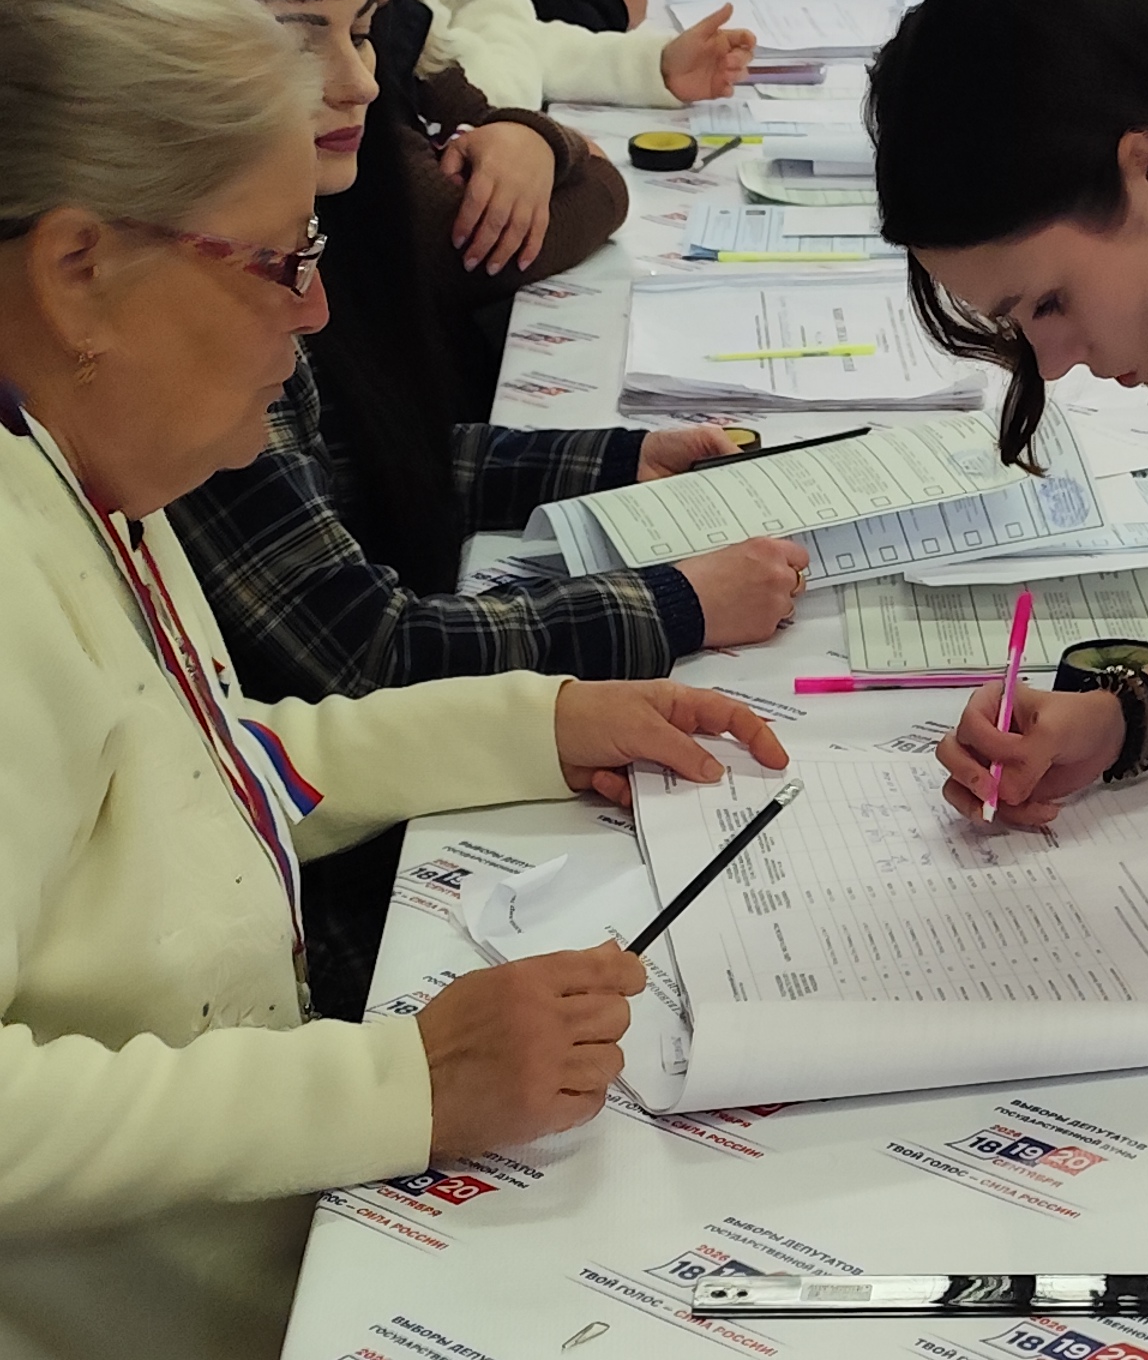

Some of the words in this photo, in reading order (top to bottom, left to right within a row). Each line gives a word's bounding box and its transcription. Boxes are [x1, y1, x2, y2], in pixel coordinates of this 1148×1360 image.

[409, 867, 439, 881] 18
[386, 1000, 419, 1015] 18
[671, 1120, 707, 1138] СИЛА
[993, 1106, 1102, 1147] ГОСУДАРСТВЕННОЙ
[1010, 1098, 1070, 1124] ВЫБОРЫ
[1066, 1118, 1148, 1152] ДЕПУТАТОВ
[968, 1136, 1004, 1155] 18
[1008, 1141, 1046, 1160] 19
[1051, 1149, 1092, 1171] 20
[886, 1141, 926, 1162] ТВОЙ
[921, 1157, 970, 1179] ГОЛОС
[979, 1178, 1019, 1199] СИЛА
[992, 1157, 1065, 1189] СЕНТЯБРЯ
[377, 1185, 443, 1217] СЕНТЯБРЯ
[442, 1178, 480, 1200] 20
[356, 1208, 391, 1227] СИЛА
[696, 1244, 731, 1263] 2026
[704, 1224, 816, 1272] ГОСУДАРСТВЕННОЙ
[723, 1216, 784, 1243] ВЫБОРЫ
[781, 1236, 865, 1276] ДЕПУТАТОВ
[669, 1260, 706, 1281] 18
[579, 1268, 620, 1289] ТВОЙ
[615, 1283, 664, 1308] ГОЛОС
[713, 1325, 779, 1358] РОССИИ!
[391, 1315, 454, 1349] ВЫБОРЫ
[914, 1337, 957, 1359] ТВОЙ
[1006, 1330, 1045, 1351] 18
[1052, 1338, 1092, 1360] 19
